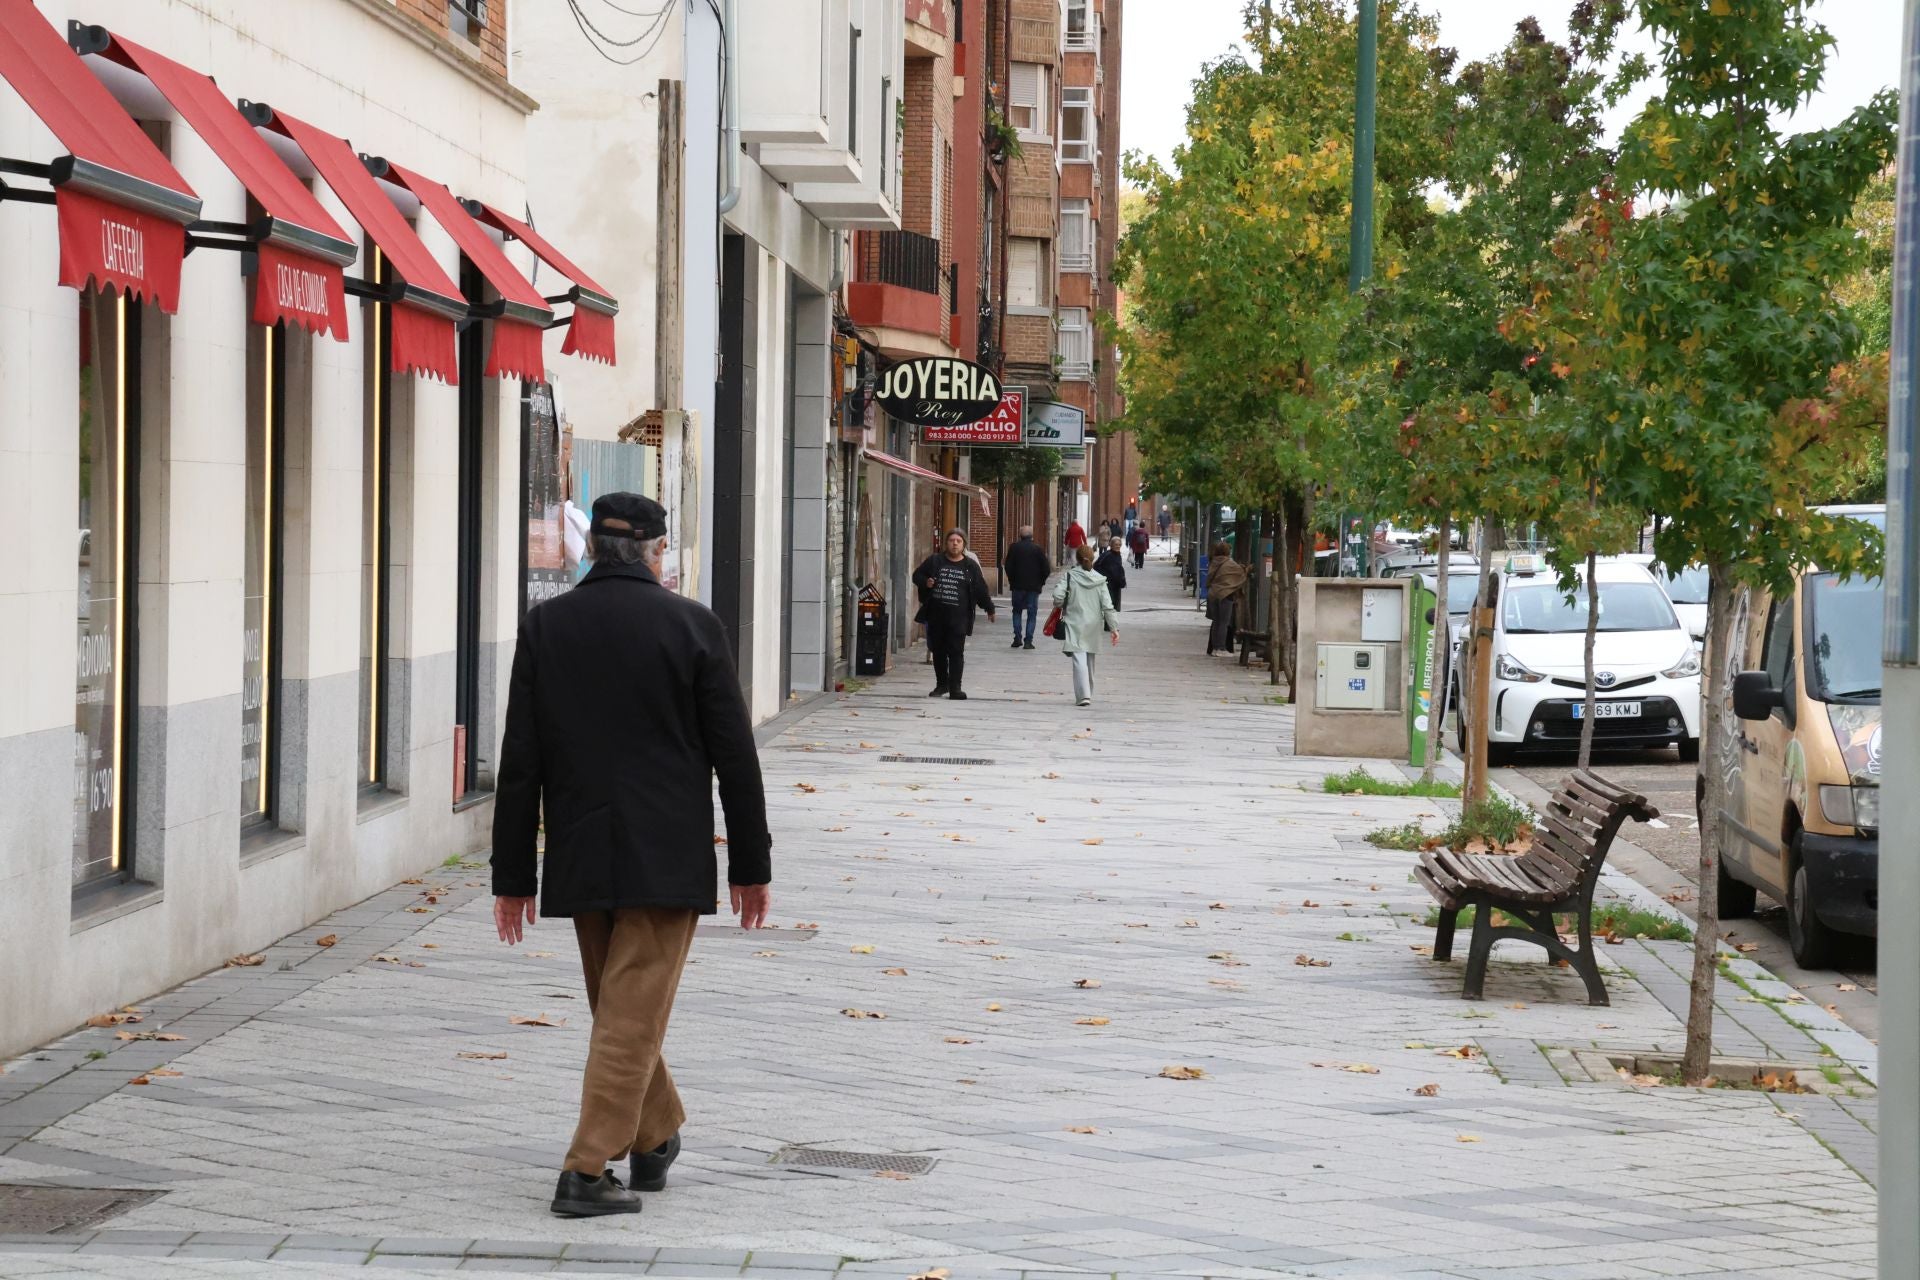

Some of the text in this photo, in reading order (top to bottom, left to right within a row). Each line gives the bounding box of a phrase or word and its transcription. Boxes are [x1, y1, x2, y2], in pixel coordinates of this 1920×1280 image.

[102, 217, 144, 280] CAFETERÍA
[277, 263, 328, 316] CASA DE COMIDAS
[876, 360, 998, 401] JOYERIA
[915, 401, 963, 425] Rey
[1580, 703, 1639, 716] 769 KMJ
